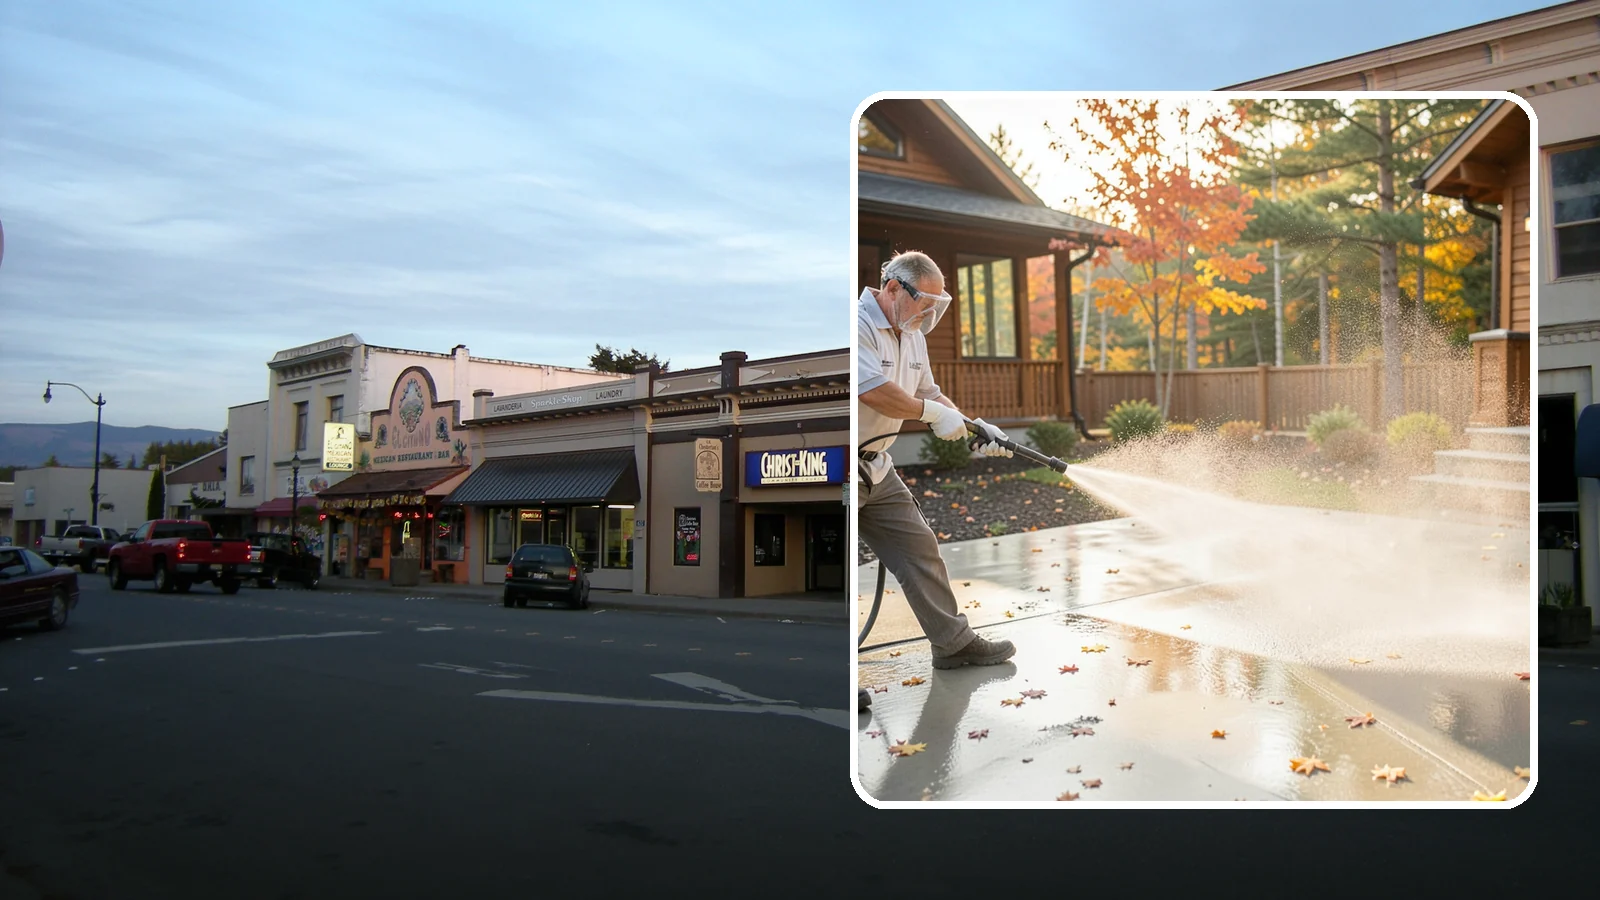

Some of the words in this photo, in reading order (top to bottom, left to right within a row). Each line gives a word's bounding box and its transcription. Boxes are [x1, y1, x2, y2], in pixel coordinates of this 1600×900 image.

[595, 388, 624, 400] LAUNDRY
[493, 402, 523, 413] LAVANDERIA
[530, 398, 561, 409] Sparkle
[562, 394, 582, 406] Shop
[373, 455, 396, 464] MEXICAN
[397, 451, 433, 462] RESTAURANT
[437, 450, 450, 459] BAR
